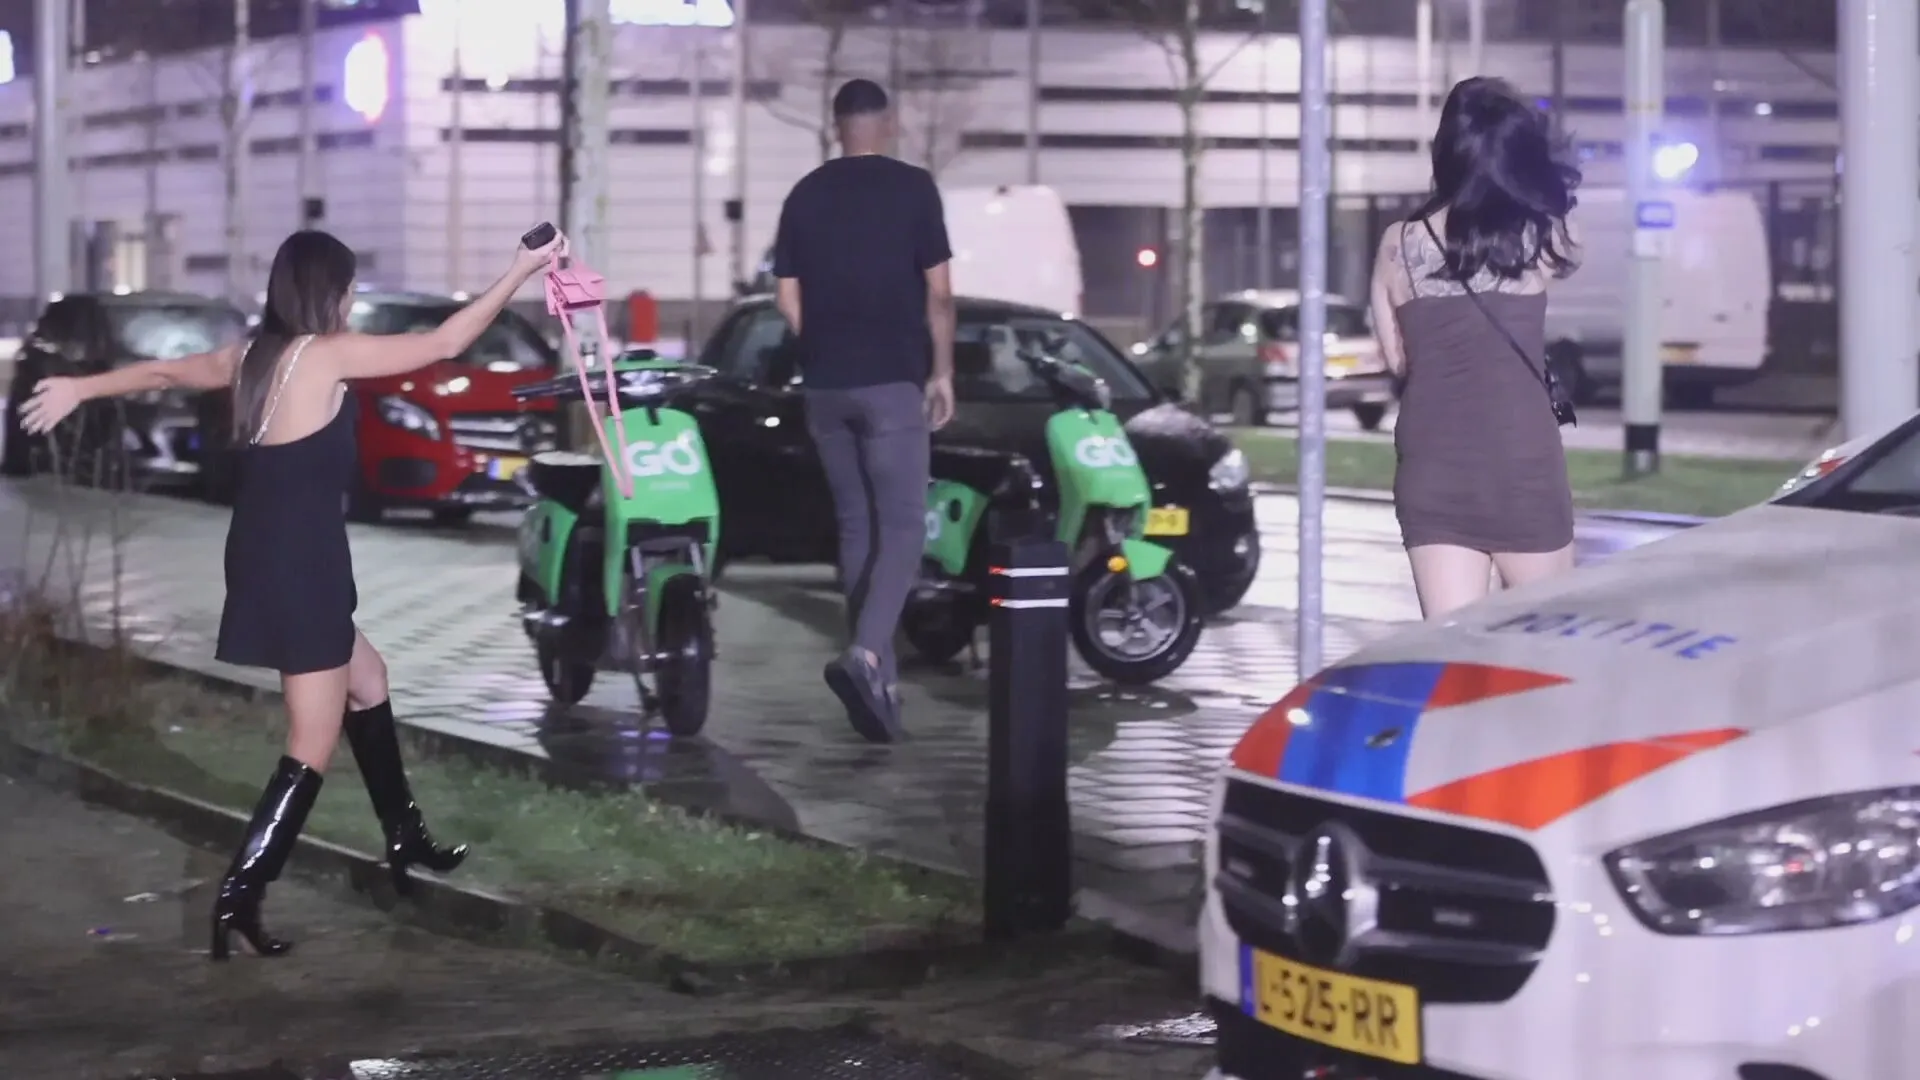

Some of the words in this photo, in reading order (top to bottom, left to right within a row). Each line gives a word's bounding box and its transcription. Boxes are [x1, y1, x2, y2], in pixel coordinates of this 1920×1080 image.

[623, 430, 701, 476] GO
[1075, 435, 1139, 469] GO
[1257, 961, 1401, 1050] L-525-RR
